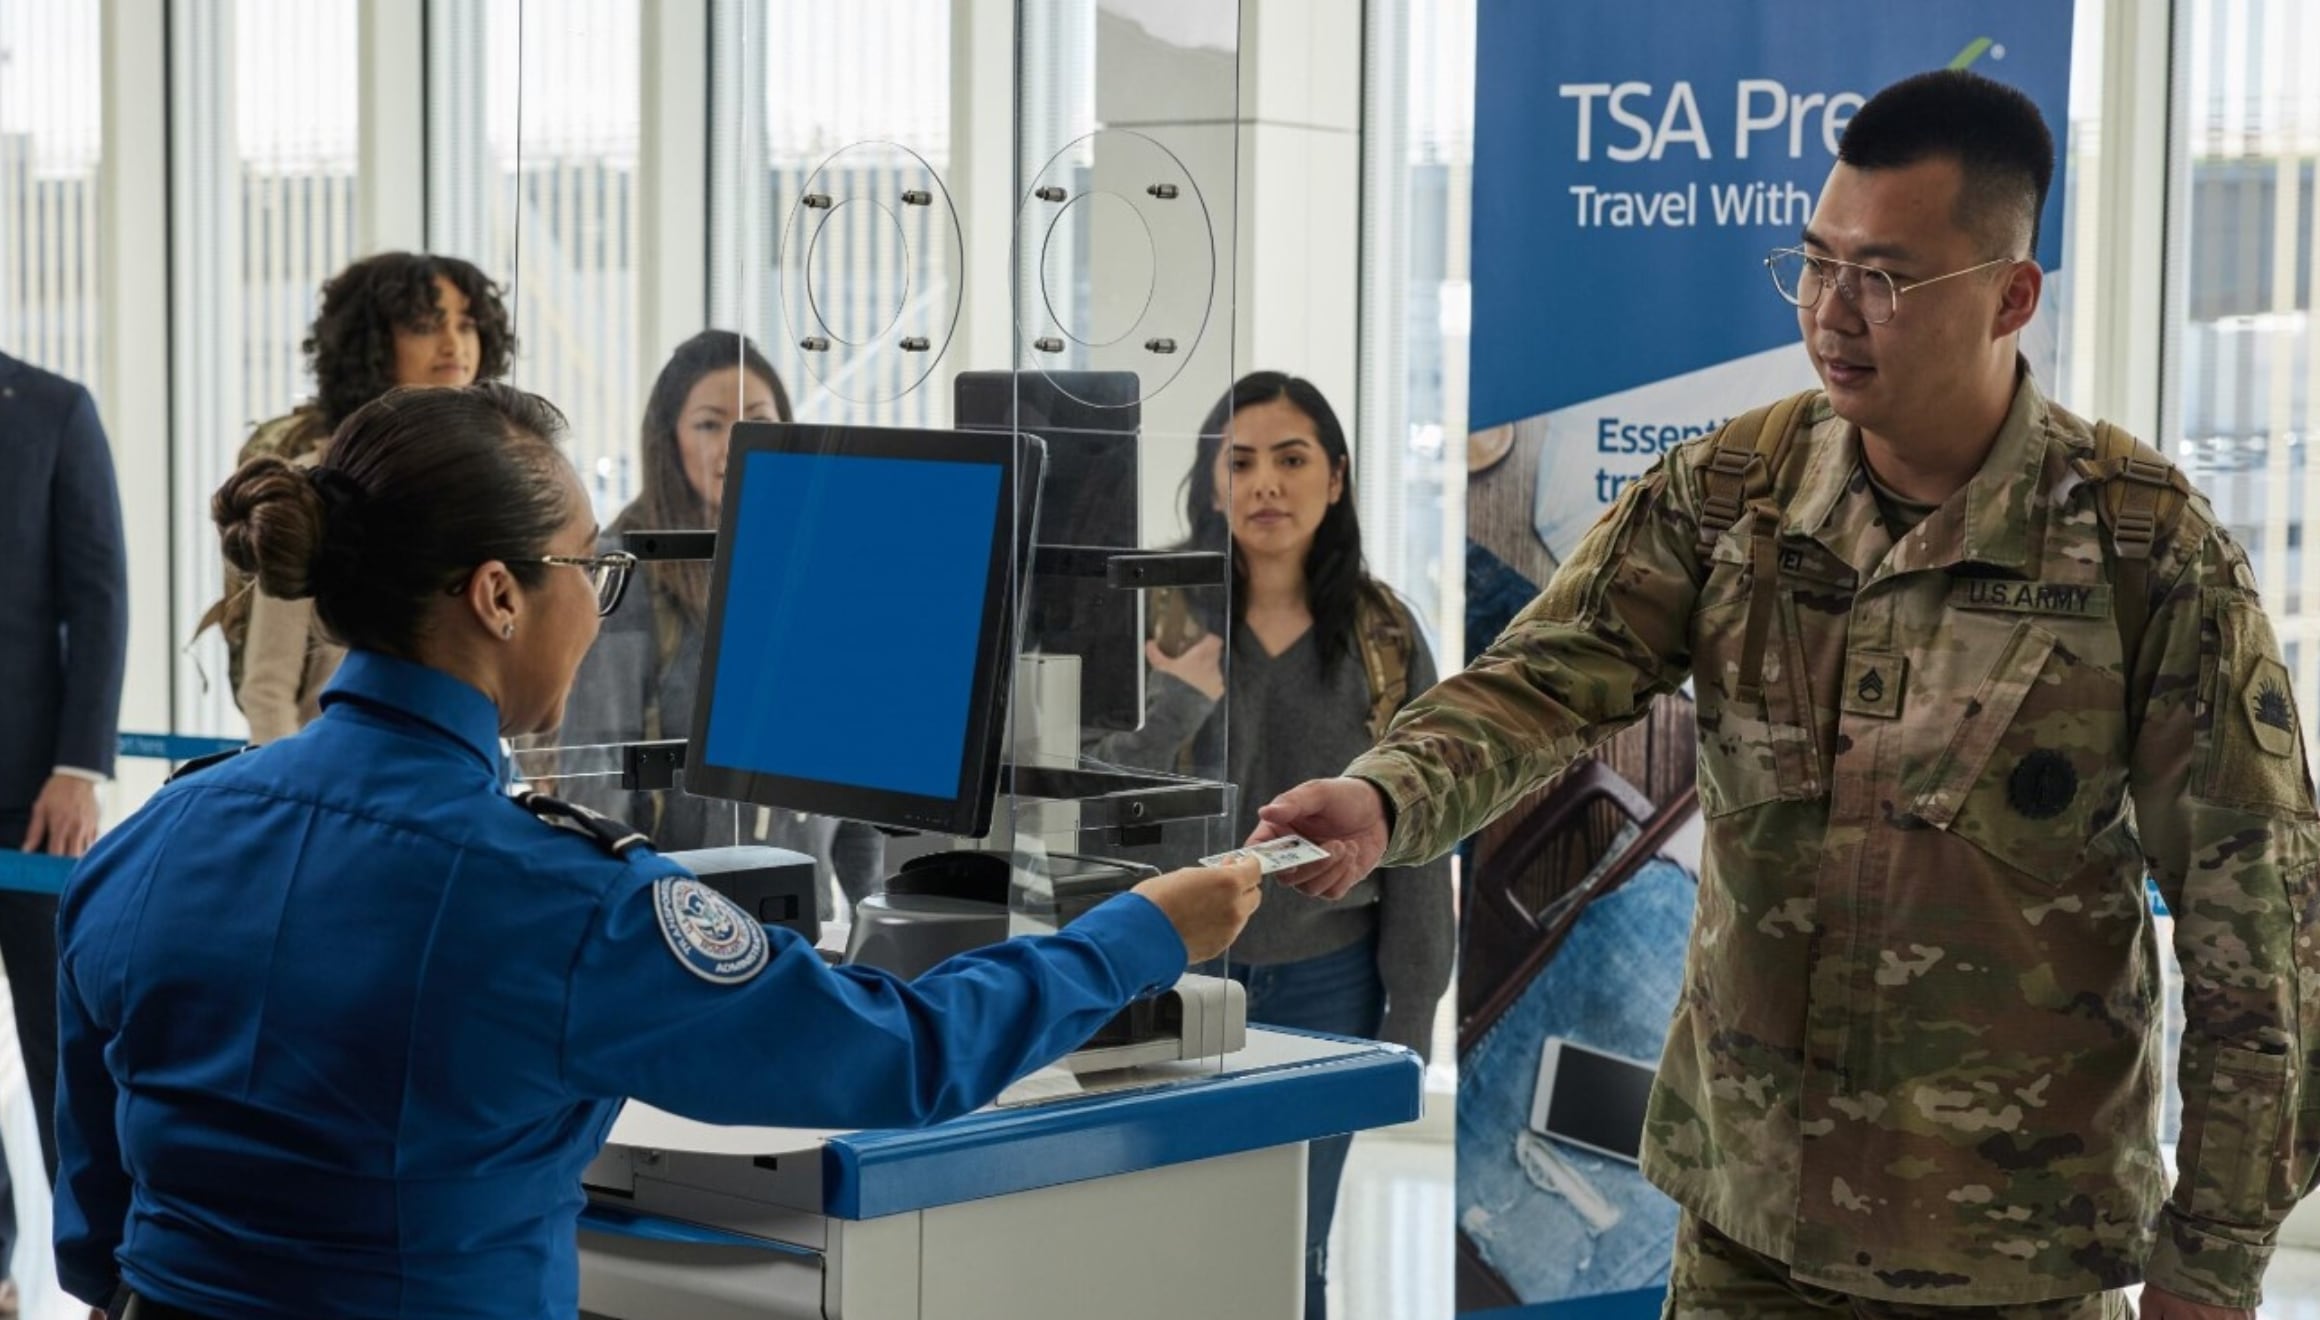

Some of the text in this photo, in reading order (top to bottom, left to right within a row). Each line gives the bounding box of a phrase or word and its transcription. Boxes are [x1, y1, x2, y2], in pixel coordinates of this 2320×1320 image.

[1559, 80, 1713, 162] TSA
[1569, 180, 1812, 227] Travel With
[1595, 467, 1641, 503] tr
[1779, 546, 1803, 572] EI
